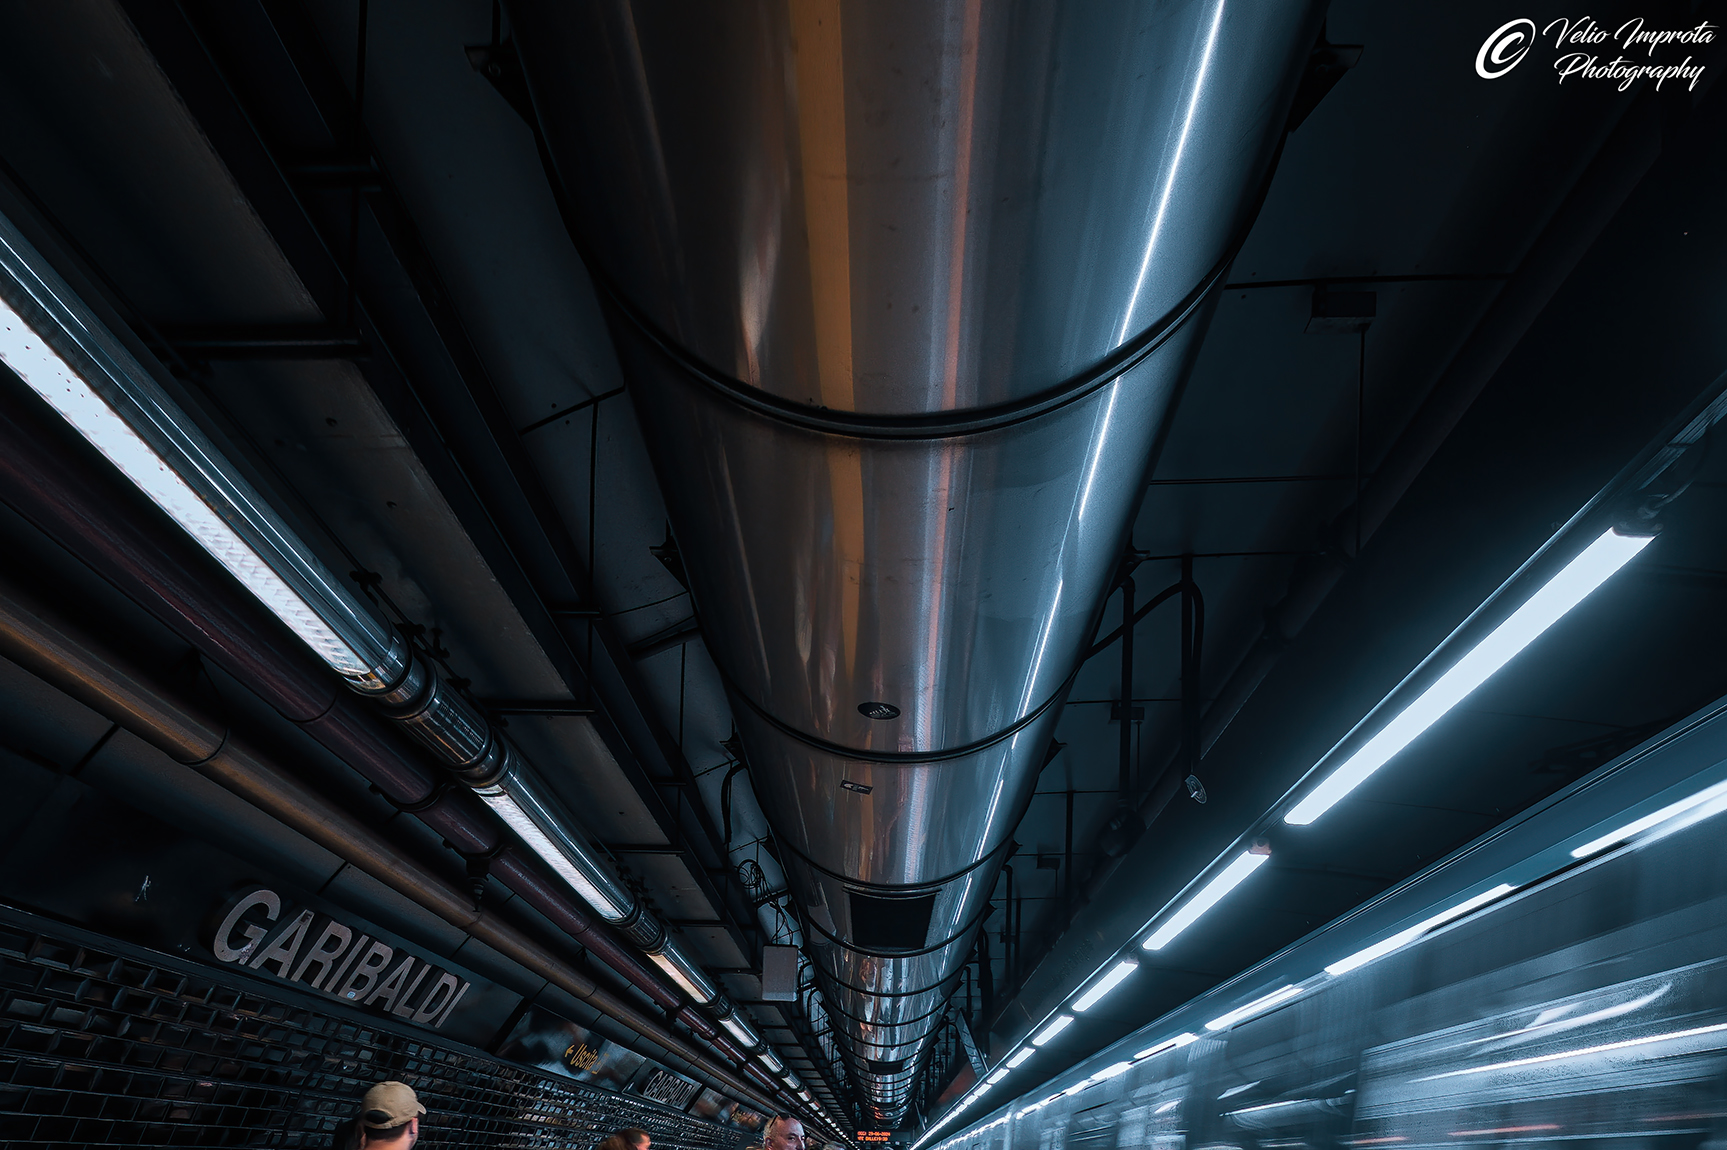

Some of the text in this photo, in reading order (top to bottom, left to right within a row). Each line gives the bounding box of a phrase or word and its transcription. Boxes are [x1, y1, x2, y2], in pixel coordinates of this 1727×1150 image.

[213, 889, 471, 1028] GARIBALDI
[570, 1043, 598, 1070] Uscita
[643, 1070, 696, 1107] GARIBALDI
